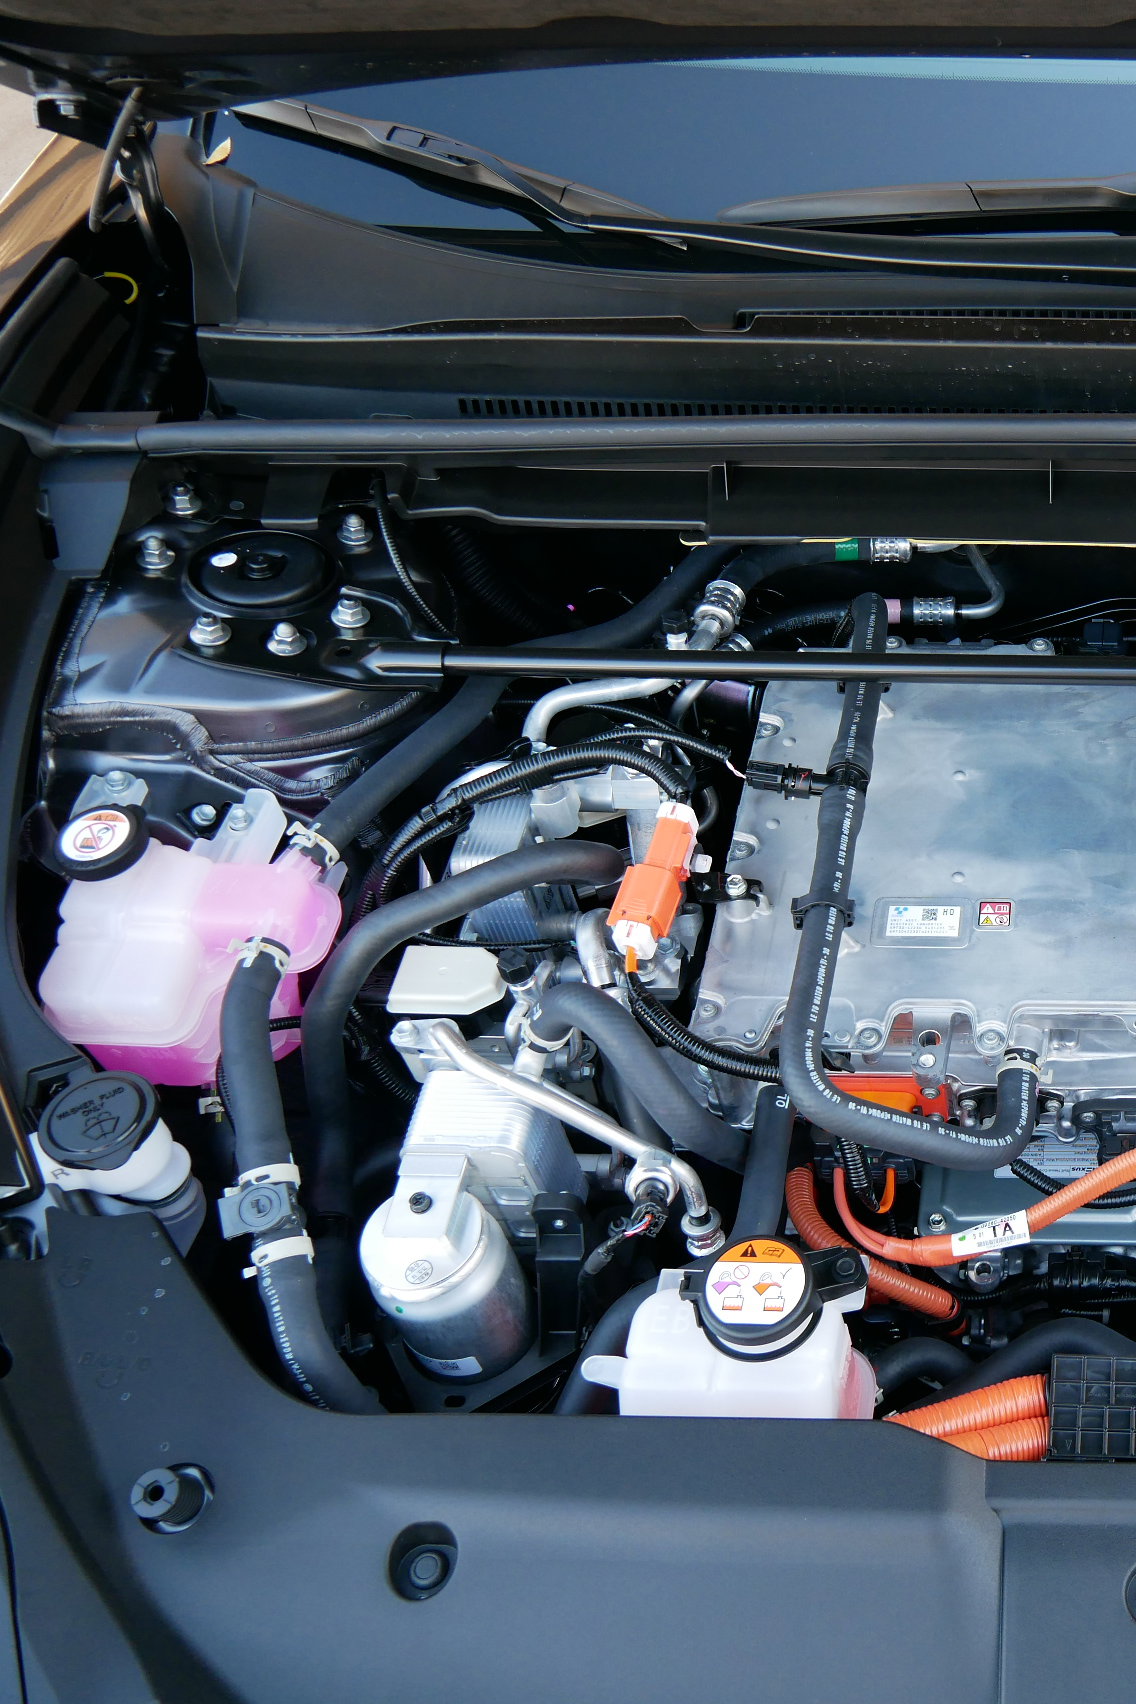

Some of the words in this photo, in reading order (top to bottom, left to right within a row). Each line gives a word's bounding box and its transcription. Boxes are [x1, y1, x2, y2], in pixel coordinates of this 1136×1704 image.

[56, 1100, 94, 1120] WASHER
[99, 1087, 124, 1100] FLUID
[82, 1102, 104, 1116] ONLY
[51, 1168, 70, 1180] R
[988, 1222, 1014, 1237] TA
